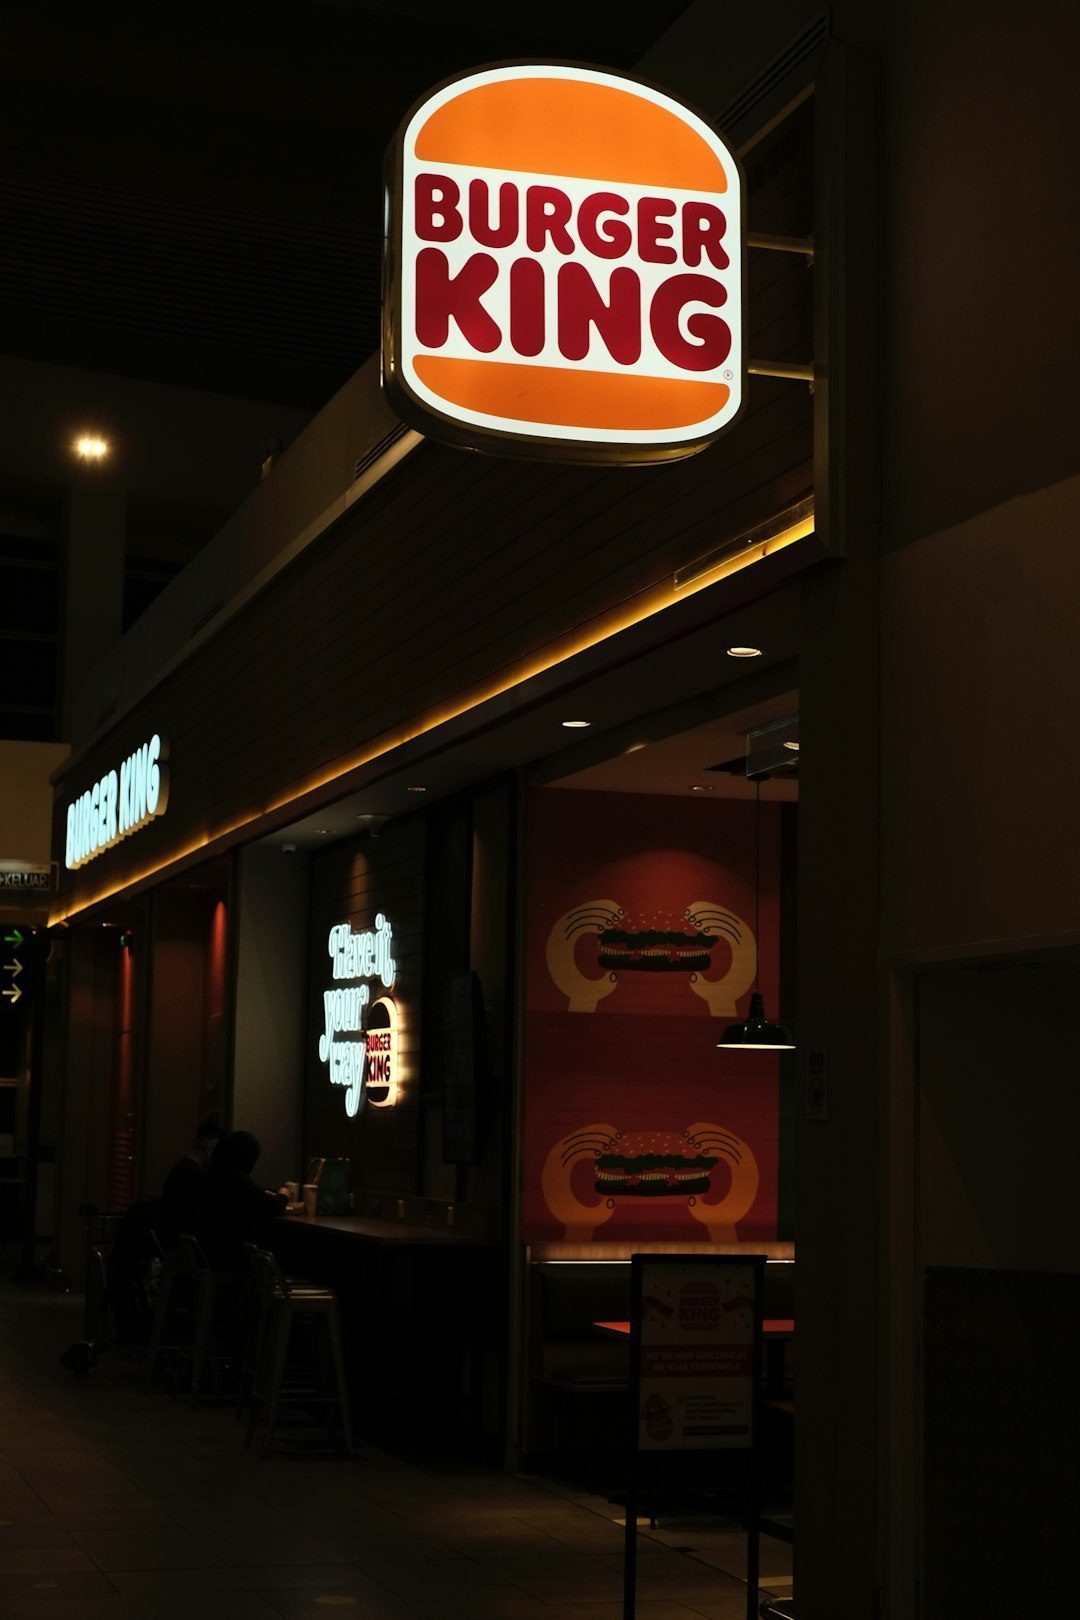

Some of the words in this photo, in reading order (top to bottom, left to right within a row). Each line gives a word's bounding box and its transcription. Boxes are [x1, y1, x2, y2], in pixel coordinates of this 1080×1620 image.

[415, 172, 731, 271] BURGER
[415, 246, 733, 373] KING
[66, 769, 118, 869] BURGER
[119, 734, 161, 835] KING
[319, 984, 370, 1064] your
[366, 1033, 391, 1052] BURGER
[329, 1040, 367, 1118] way
[365, 1055, 391, 1082] KING
[679, 1308, 721, 1322] KING
